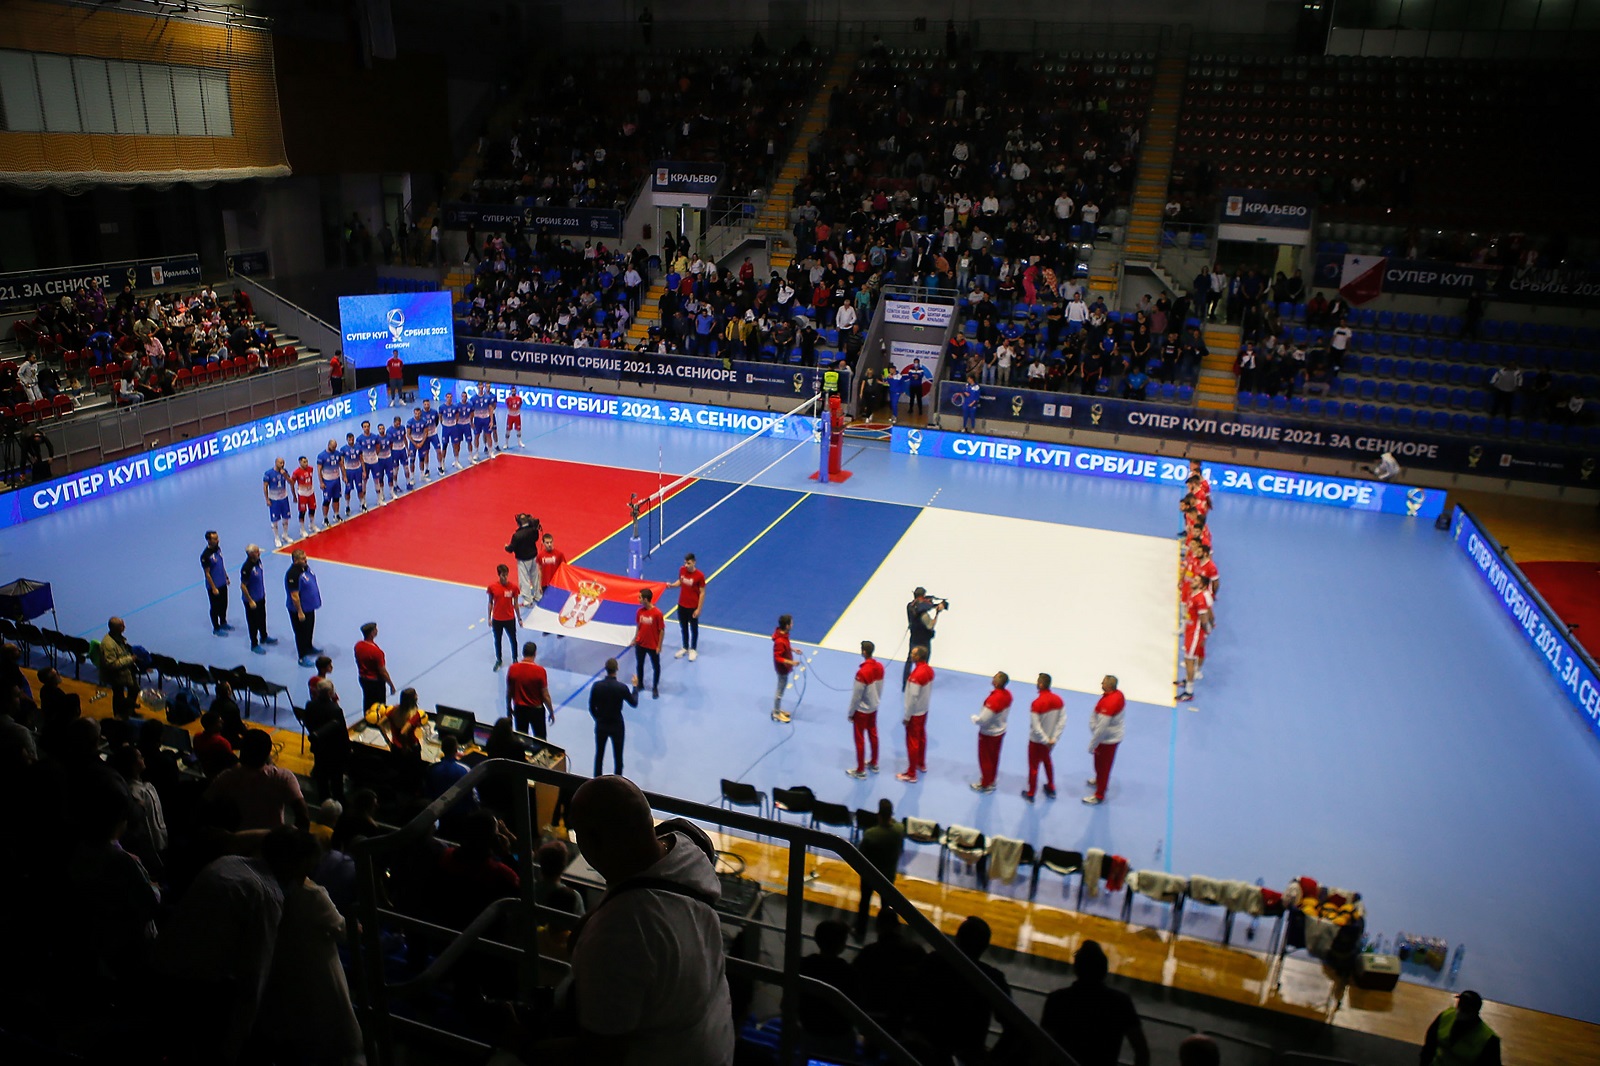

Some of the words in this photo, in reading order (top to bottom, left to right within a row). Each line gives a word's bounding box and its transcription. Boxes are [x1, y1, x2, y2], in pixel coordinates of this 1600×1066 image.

[670, 173, 718, 183] КРАЉЕВО
[1244, 202, 1307, 216] КРАЉЕВО
[482, 214, 505, 222] СУПЕР
[535, 216, 562, 226] СРБИЈЕ
[563, 218, 580, 226] 2021
[1386, 269, 1437, 284] СУПЕР
[1440, 273, 1475, 287] КУП
[23, 282, 44, 297] ЗА
[346, 331, 371, 341] СУПЕР
[372, 330, 389, 340] КУП
[403, 328, 431, 337] СРБИЈЕ
[431, 326, 448, 335] 2021
[510, 350, 549, 364] СУПЕР
[551, 353, 575, 367] КУП
[577, 356, 622, 371] СРБИЈЕ
[623, 360, 655, 375] 2021.
[657, 363, 674, 377] ЗА
[676, 366, 738, 382] СЕНИОРЕ
[519, 390, 553, 408] КУП
[556, 395, 618, 415] СРБИЈЕ
[621, 401, 666, 421] 2021.
[669, 407, 694, 424] ЗА
[1127, 411, 1181, 428] СУПЕР
[1182, 418, 1218, 434] КУП
[1220, 421, 1281, 441] СРБИЈЕ
[1283, 428, 1326, 446] 2021.
[1329, 433, 1351, 448] ЗА
[1354, 437, 1439, 459] СЕНИОРЕ
[33, 473, 104, 509] СУПЕР
[108, 458, 151, 487] КУП
[153, 437, 220, 472] СРБИЈЕ
[222, 427, 263, 452] 2021.
[265, 421, 286, 439] ЗА
[287, 398, 352, 431] СЕНИОРЕ
[952, 438, 1022, 461] СУПЕР
[1025, 446, 1071, 467] КУП
[1074, 452, 1158, 478] СРБИЈЕ
[1160, 462, 1218, 486] 201.
[1222, 470, 1254, 490] ЗА
[1257, 474, 1373, 505] СЕНИОРЕ
[1534, 623, 1561, 672] 2021.
[1561, 656, 1580, 694] ЗА
